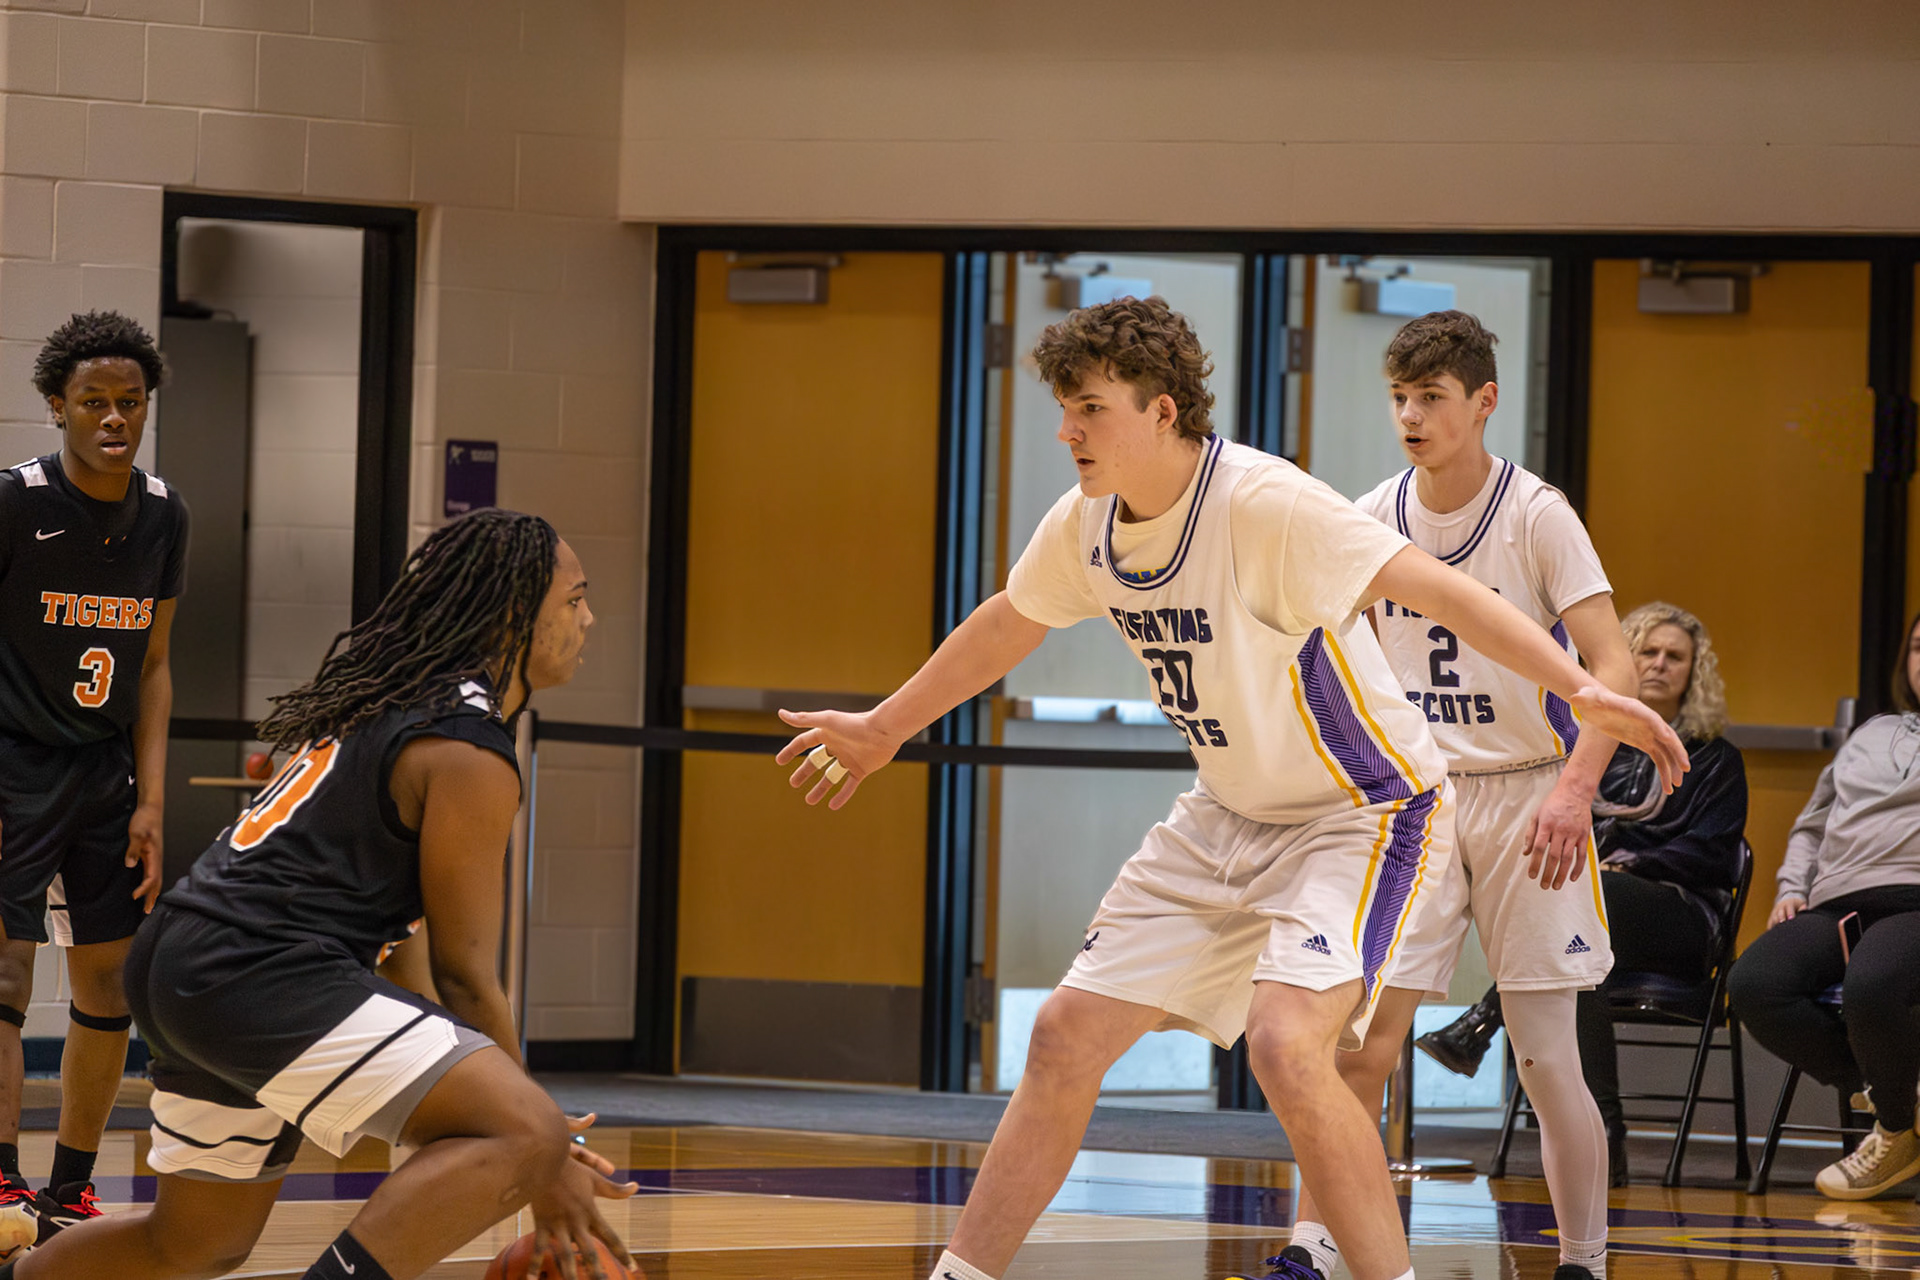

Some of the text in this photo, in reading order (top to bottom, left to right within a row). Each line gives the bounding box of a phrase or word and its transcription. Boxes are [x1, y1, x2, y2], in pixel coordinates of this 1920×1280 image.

[41, 591, 154, 630] TIGERS
[1109, 607, 1213, 643] FIGHTING
[72, 647, 115, 708] 3
[1427, 625, 1460, 687] 2
